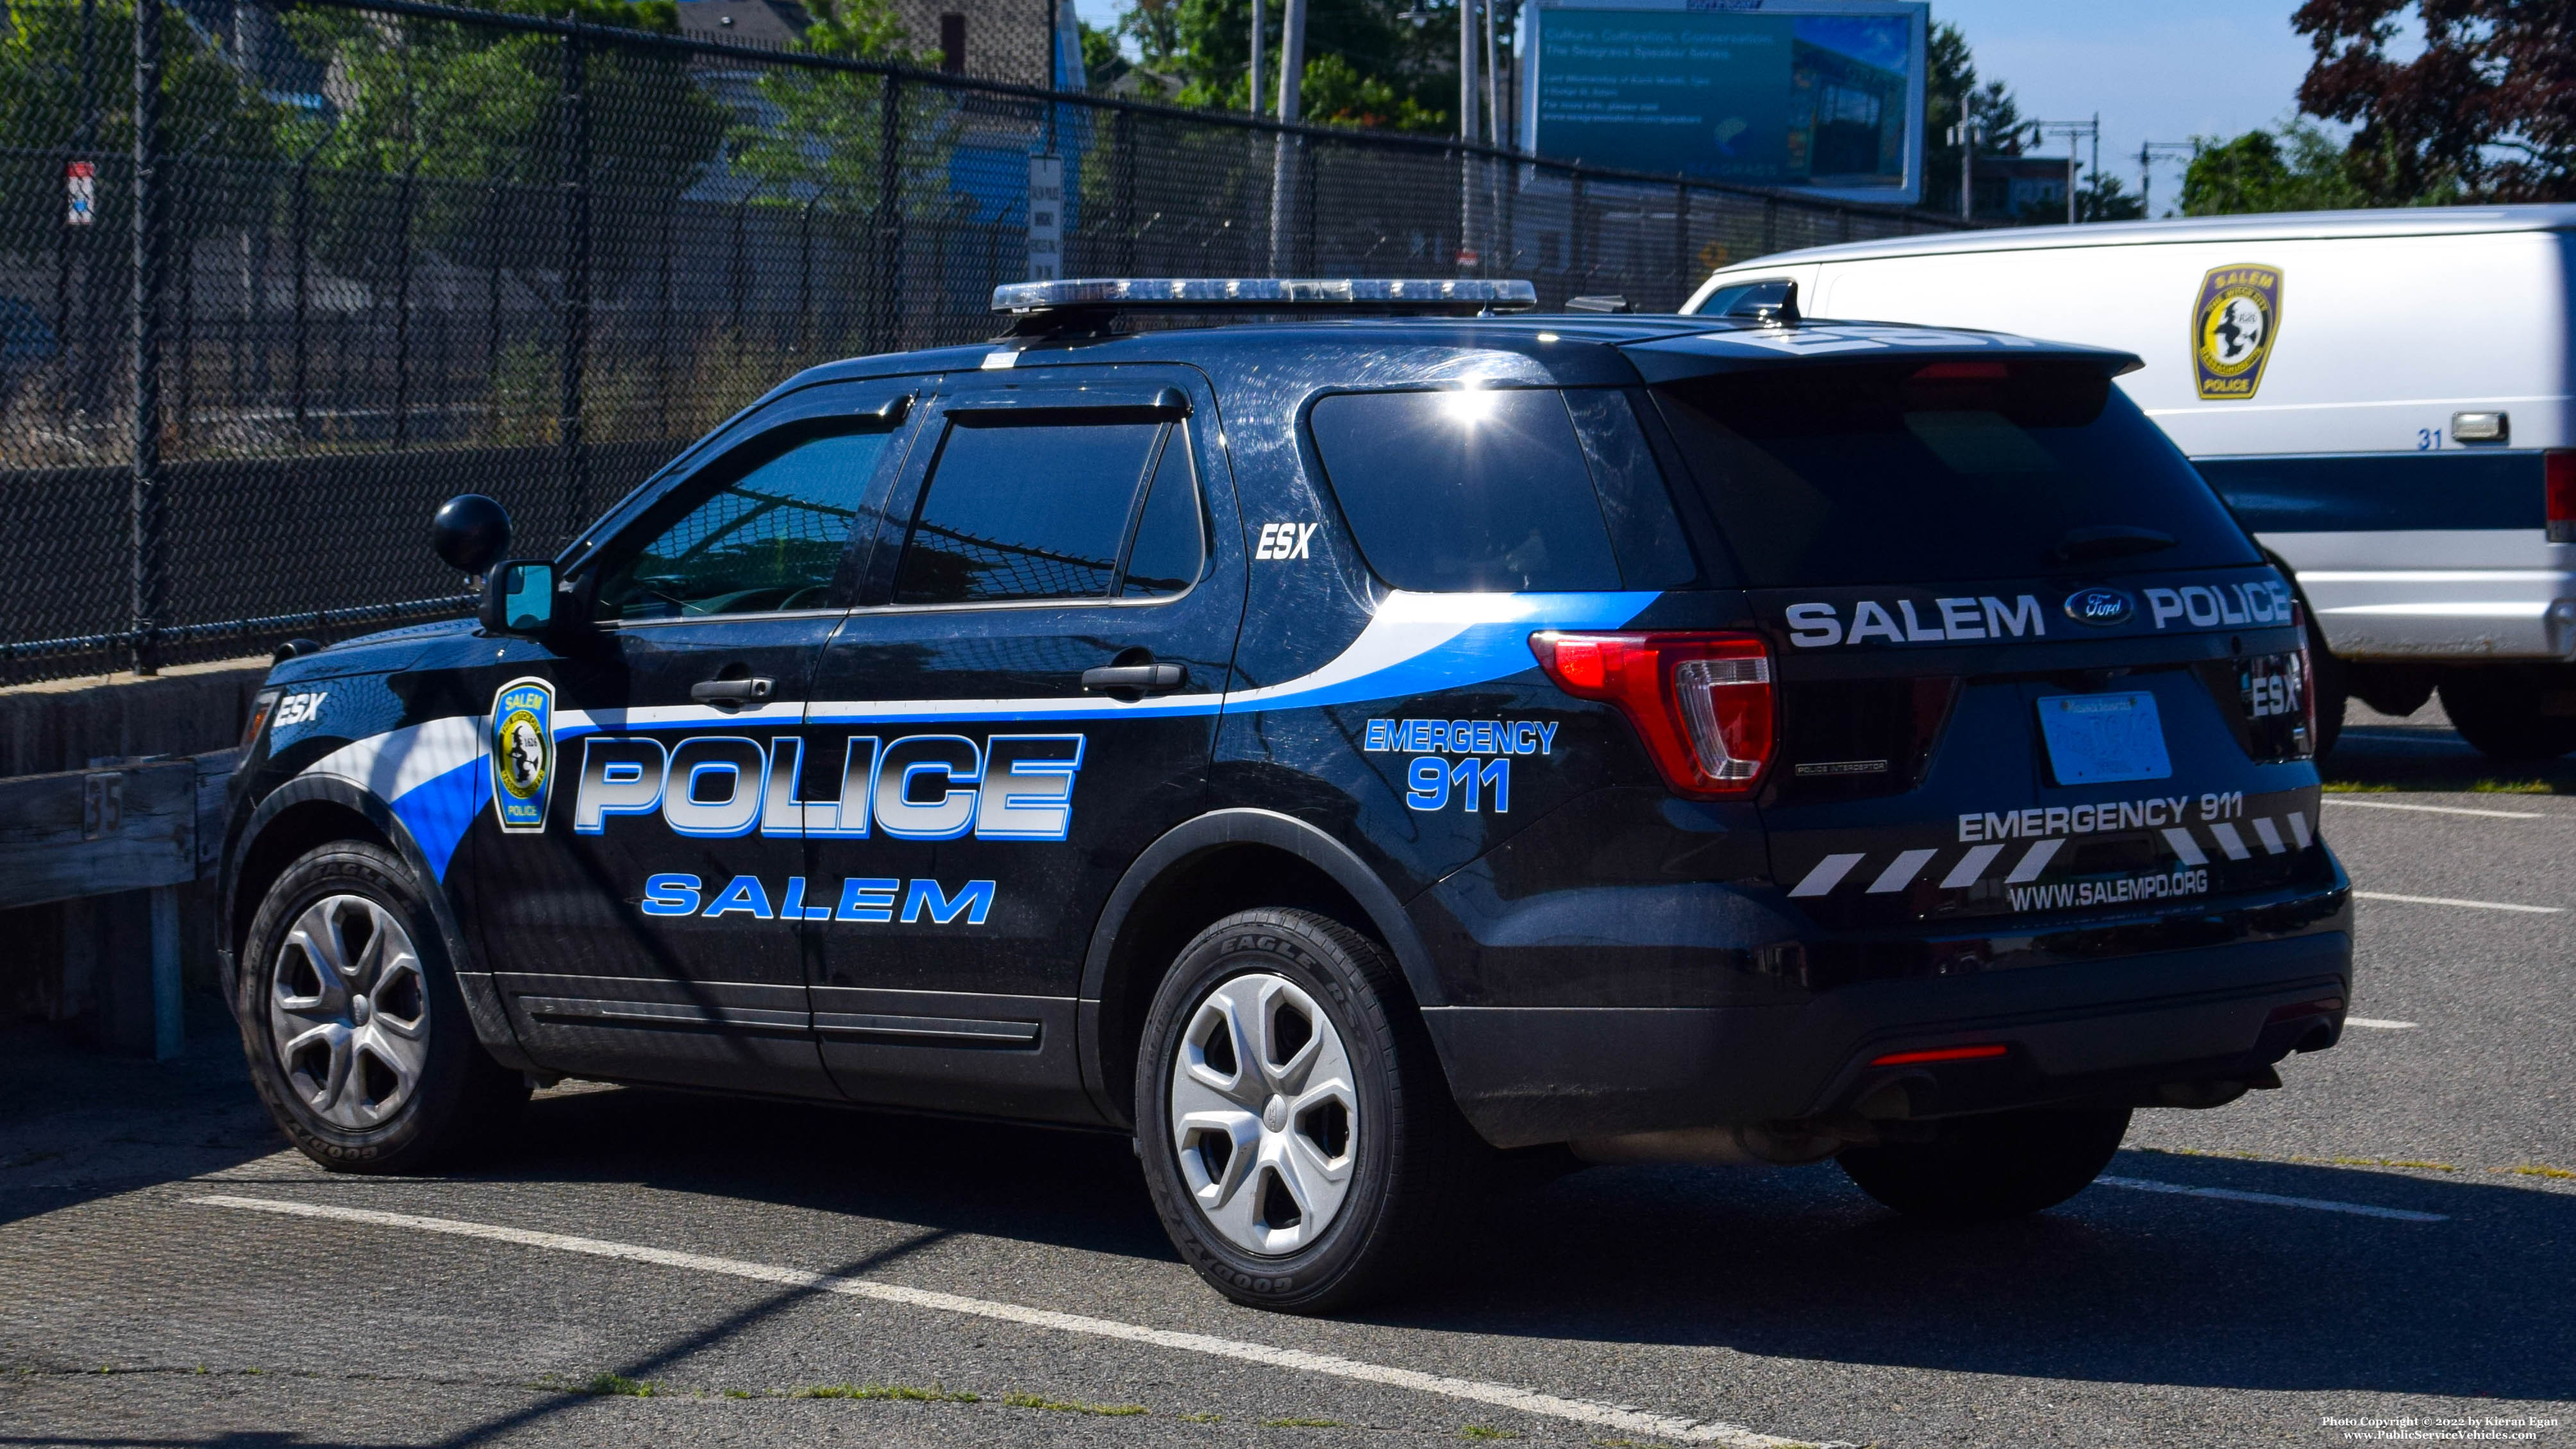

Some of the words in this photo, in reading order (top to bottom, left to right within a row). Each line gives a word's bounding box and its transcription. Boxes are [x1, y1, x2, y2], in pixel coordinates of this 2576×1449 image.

[2214, 271, 2275, 289] SALEM
[2204, 378, 2250, 392] POLICE
[2418, 428, 2443, 450] 31
[1255, 523, 1318, 560] ESX
[1786, 595, 2045, 648] SALEM
[2086, 594, 2121, 617] Ford
[2144, 580, 2292, 629] POLICE
[272, 692, 328, 728] ESX
[505, 692, 544, 711] SALEM
[2252, 674, 2300, 717] ESX
[1364, 719, 1559, 755] EMERGENCY
[574, 734, 1087, 841] POLICE
[1407, 757, 1510, 813] 911
[508, 805, 537, 816] POLICE
[1959, 795, 2189, 842] EMERGENCY
[2201, 791, 2243, 821] 911
[641, 873, 996, 925] SALEM
[2010, 869, 2208, 912] WWW.SALEMPD.ORG
[1220, 935, 1317, 969] EAGLE
